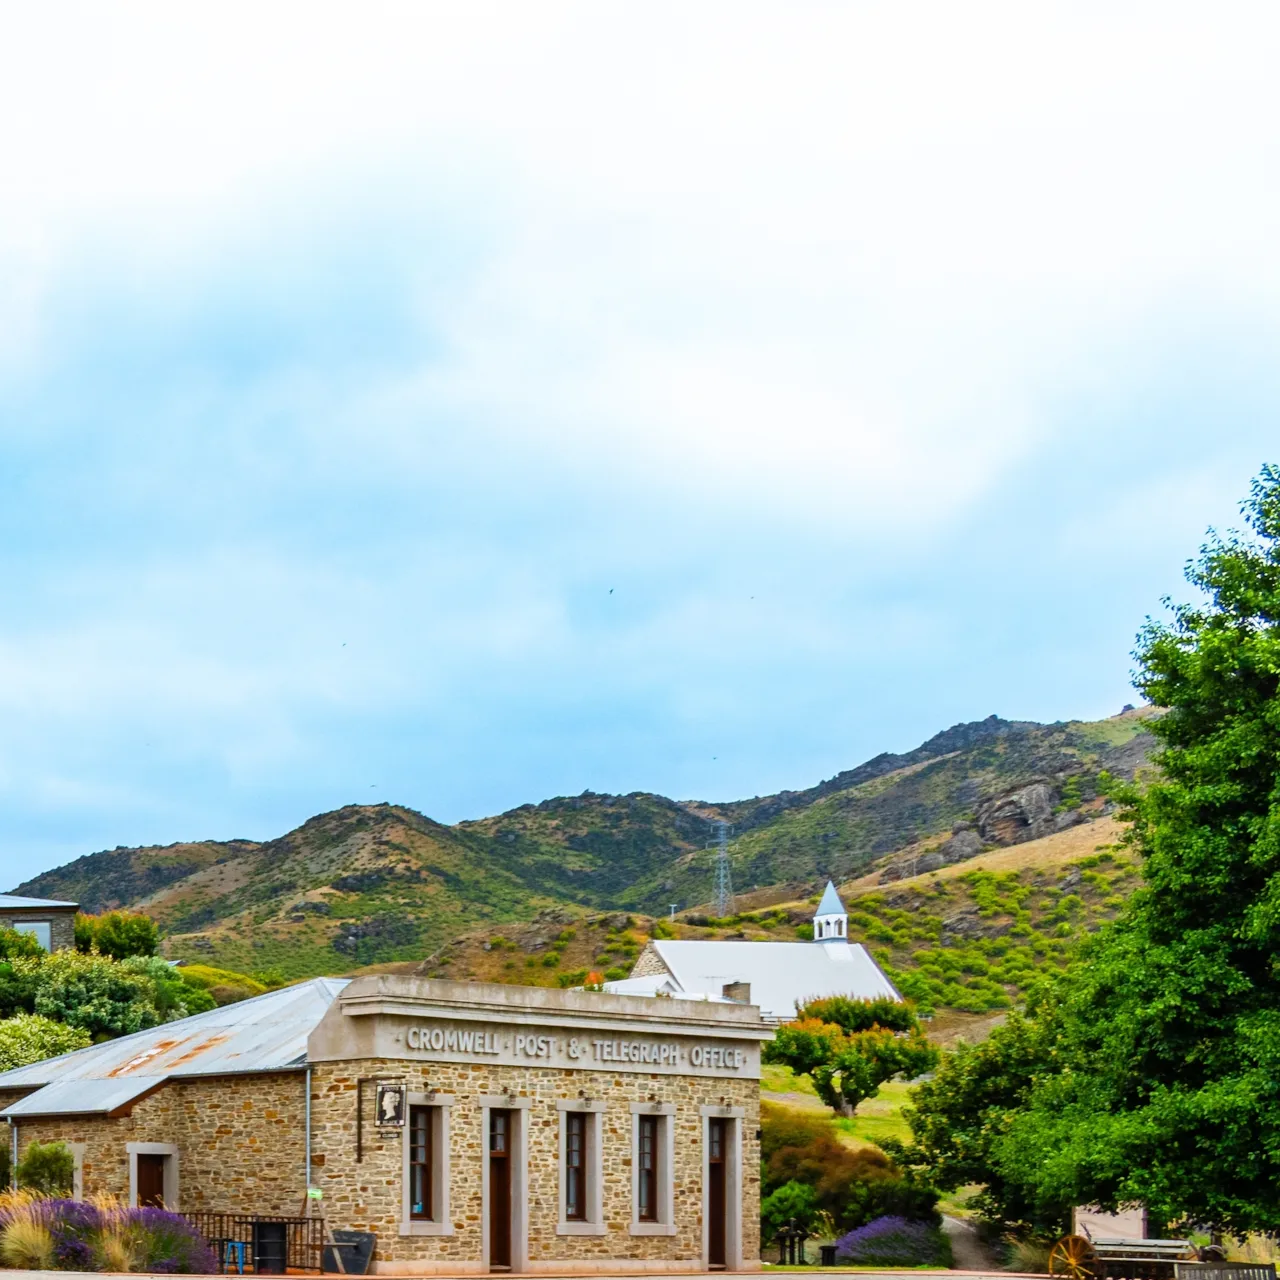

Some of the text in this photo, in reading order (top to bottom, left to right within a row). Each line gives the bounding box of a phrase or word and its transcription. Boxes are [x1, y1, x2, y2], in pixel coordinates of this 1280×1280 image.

[407, 1027, 741, 1069] CROMWELL POST & TELEGRAPH OFFICE
